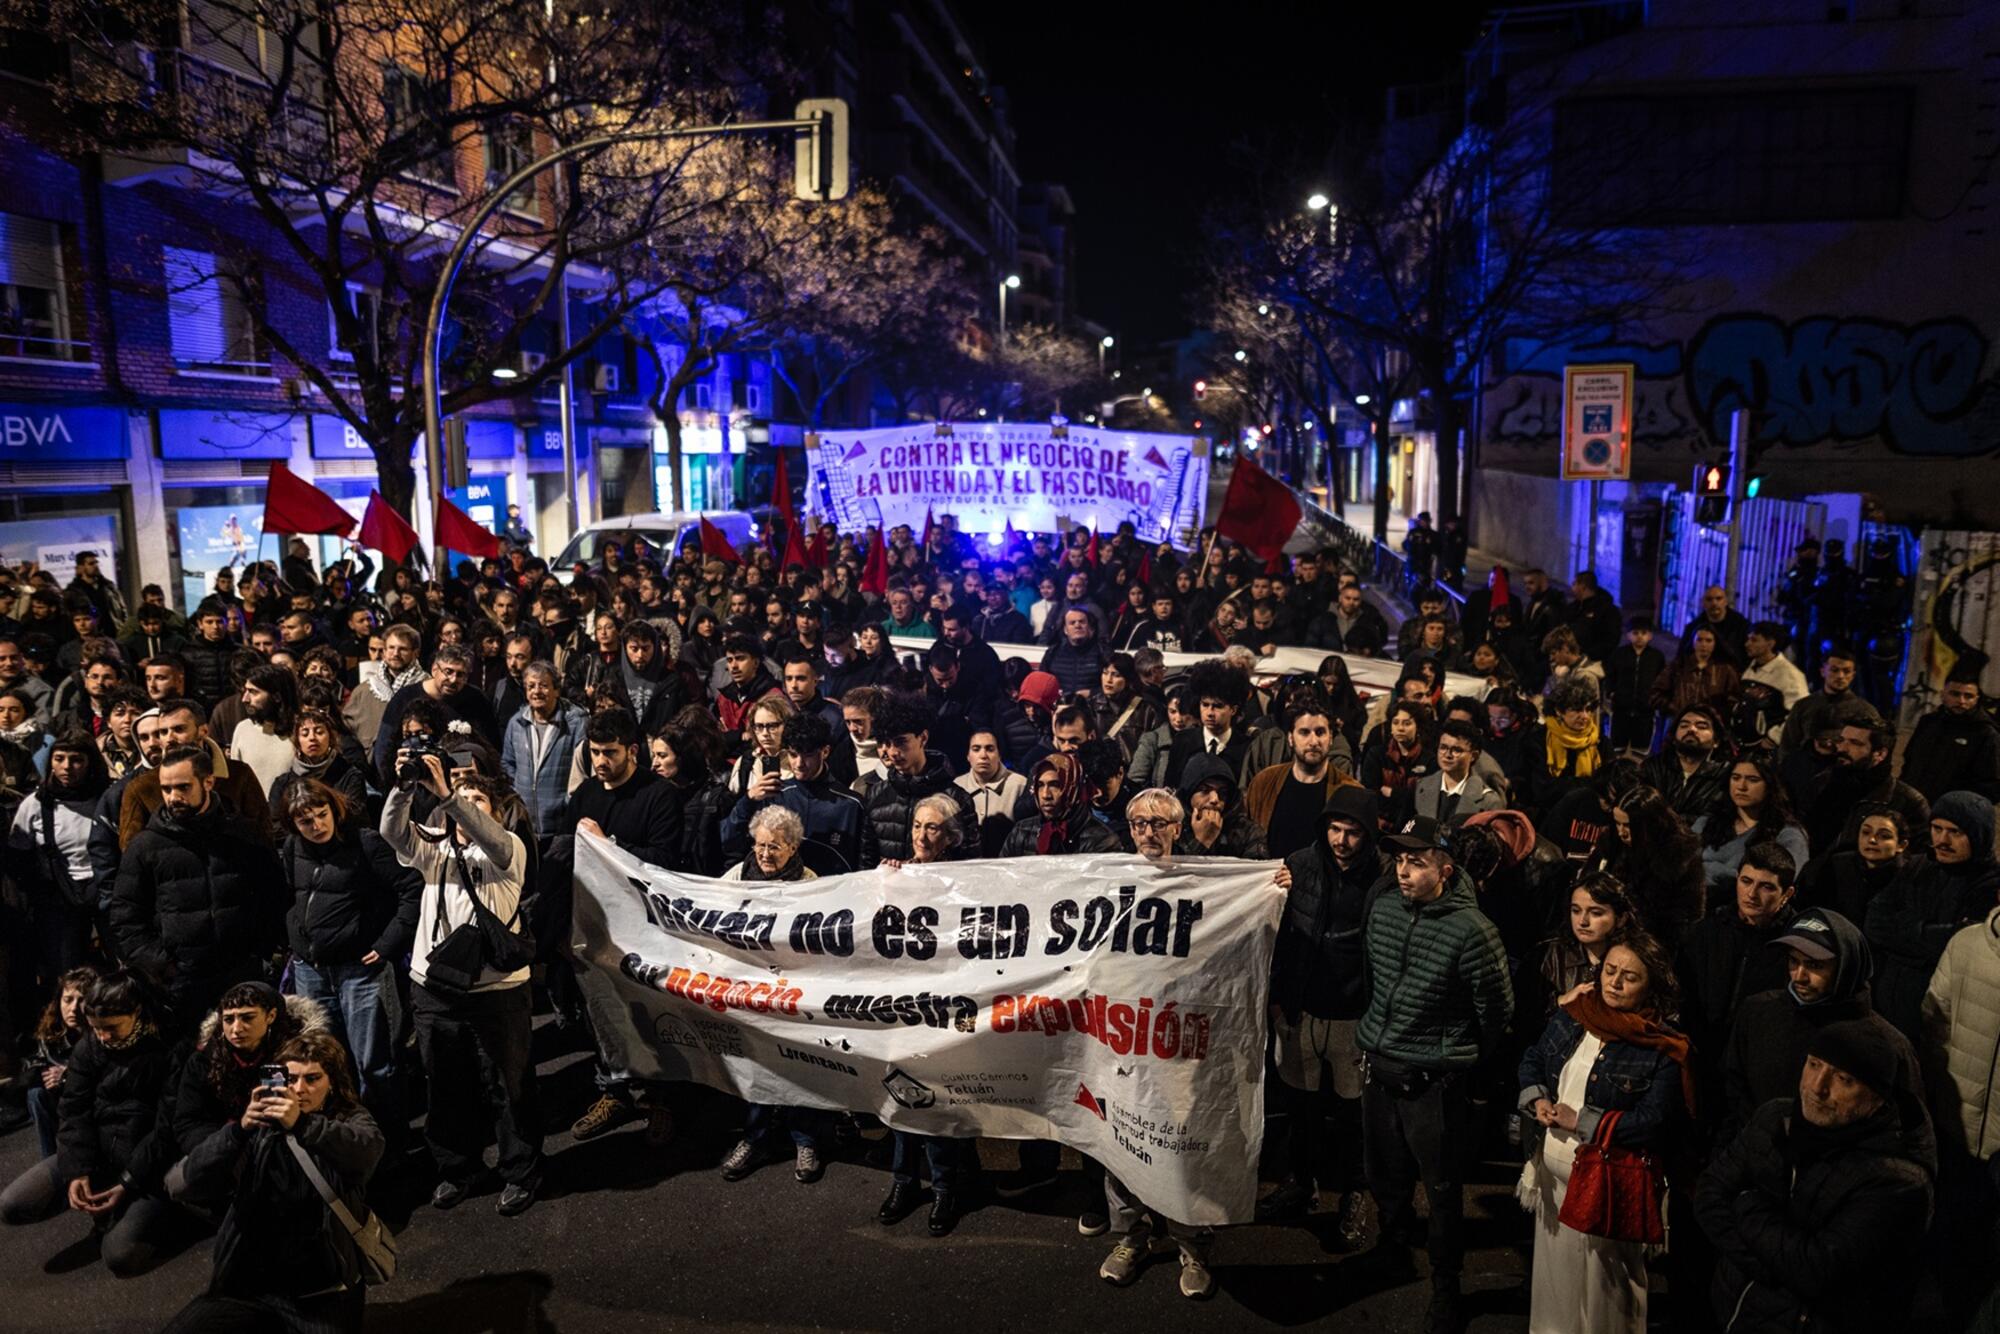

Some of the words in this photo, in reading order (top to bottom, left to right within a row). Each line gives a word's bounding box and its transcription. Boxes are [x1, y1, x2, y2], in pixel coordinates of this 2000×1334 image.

[0, 414, 72, 446] BVA
[880, 442, 963, 469] CONTRA
[970, 442, 994, 467] EL
[1000, 442, 1095, 470] NEGOCIO
[1100, 448, 1129, 476] DE
[467, 484, 491, 500] BBVA
[856, 472, 883, 497] LA
[887, 469, 990, 496] VIVIENDA
[993, 469, 1006, 494] Y
[1012, 469, 1036, 495] EL
[1040, 470, 1151, 506] FASCISMO
[628, 875, 778, 951] Tetuán
[789, 908, 855, 957] no
[871, 904, 939, 960] es
[957, 903, 1031, 960] un
[1044, 885, 1204, 957] solar
[991, 993, 1211, 1060] expulsión
[777, 1043, 859, 1077] Lorenzana
[943, 1083, 995, 1095] Tetuán
[1149, 1134, 1209, 1156] trabajadora
[1160, 1121, 1174, 1135] de
[1177, 1122, 1188, 1135] la
[1112, 1125, 1153, 1166] Tetuán
